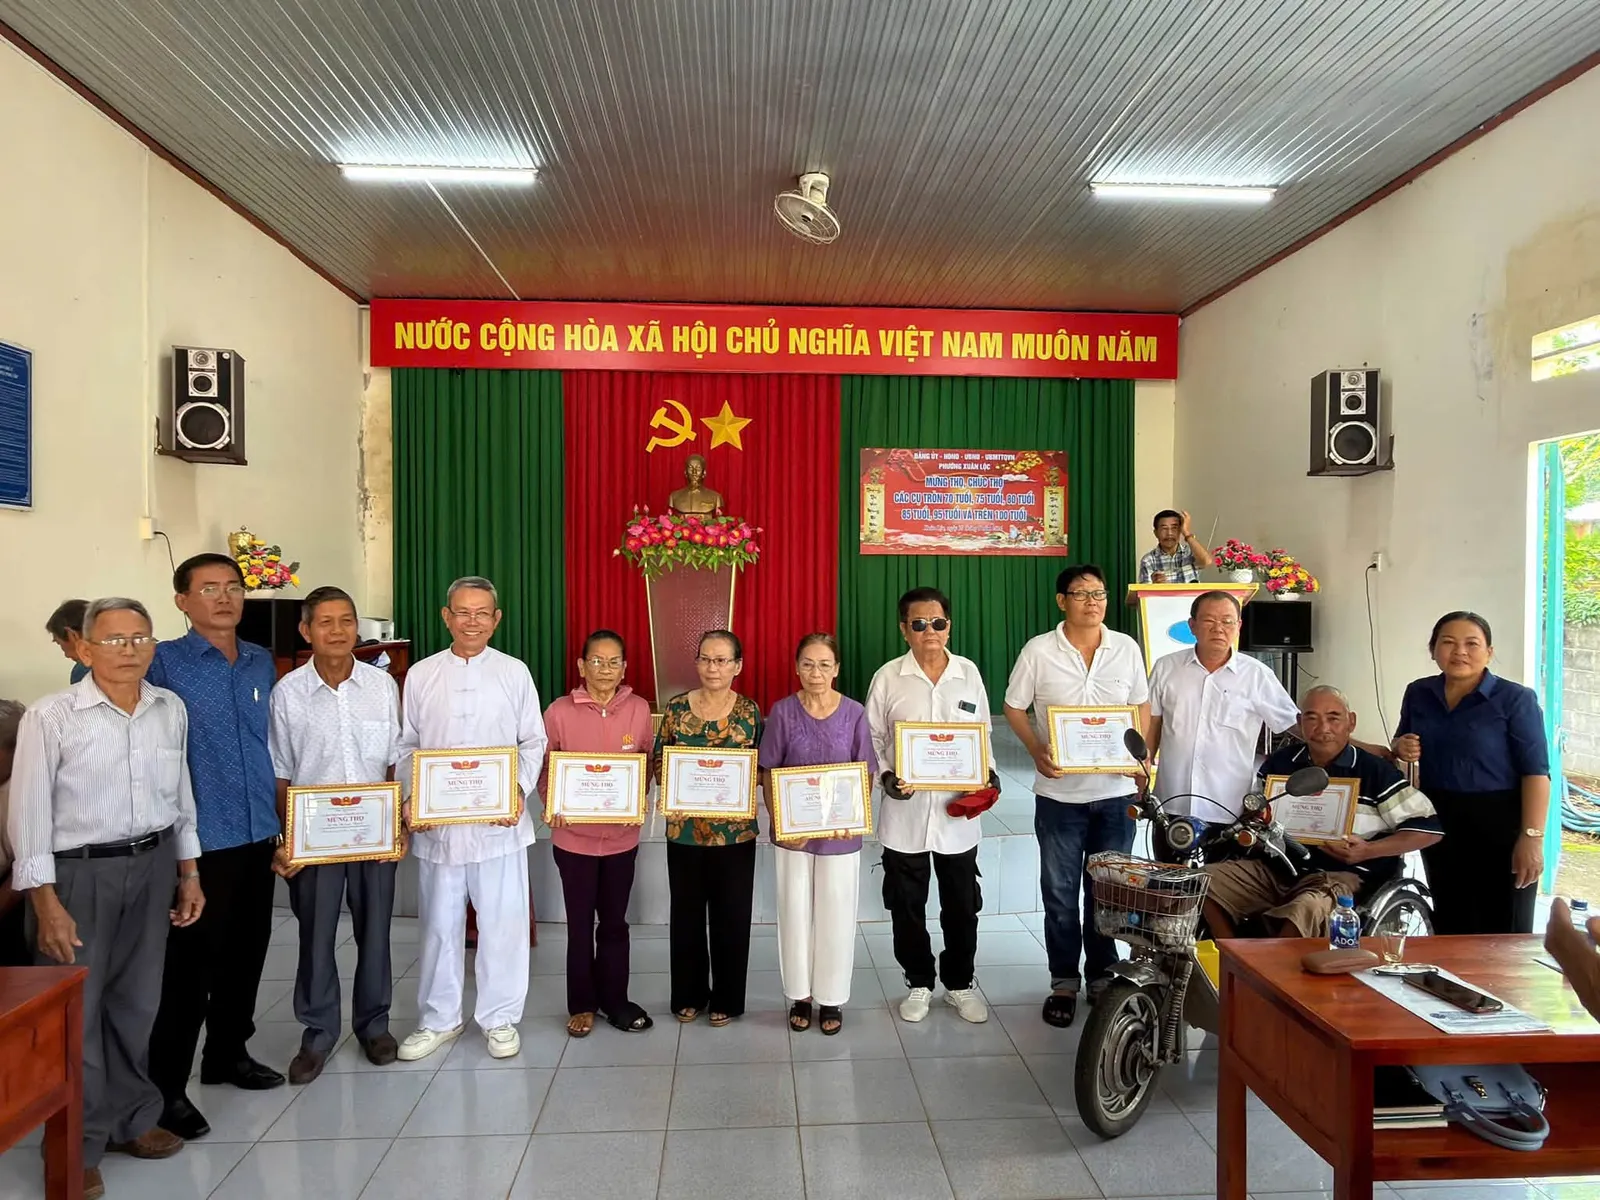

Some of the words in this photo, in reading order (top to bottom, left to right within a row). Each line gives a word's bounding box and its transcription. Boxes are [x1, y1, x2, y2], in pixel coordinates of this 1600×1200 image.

[394, 316, 471, 350] NƯỚC
[479, 317, 555, 357] CỘNG
[564, 318, 620, 352] HÒA
[627, 320, 665, 353] XÃ
[672, 321, 717, 359] HỘI
[725, 318, 779, 354] CHỦ
[788, 323, 871, 356] NGHĨA
[879, 325, 934, 363] VIỆT
[942, 331, 1003, 359] NAM
[1011, 328, 1089, 361] MUÔN
[1097, 330, 1157, 362] NĂM
[894, 490, 910, 504] CÁC
[911, 492, 922, 506] CỤ
[923, 490, 943, 504] TRÒN
[944, 493, 954, 504] 70
[976, 493, 986, 504] 75
[1006, 494, 1016, 505] 80
[901, 509, 912, 520] 85
[933, 509, 944, 520] 95
[963, 507, 973, 520] VÀ
[974, 507, 993, 520] TRÊN
[995, 509, 1009, 521] 100
